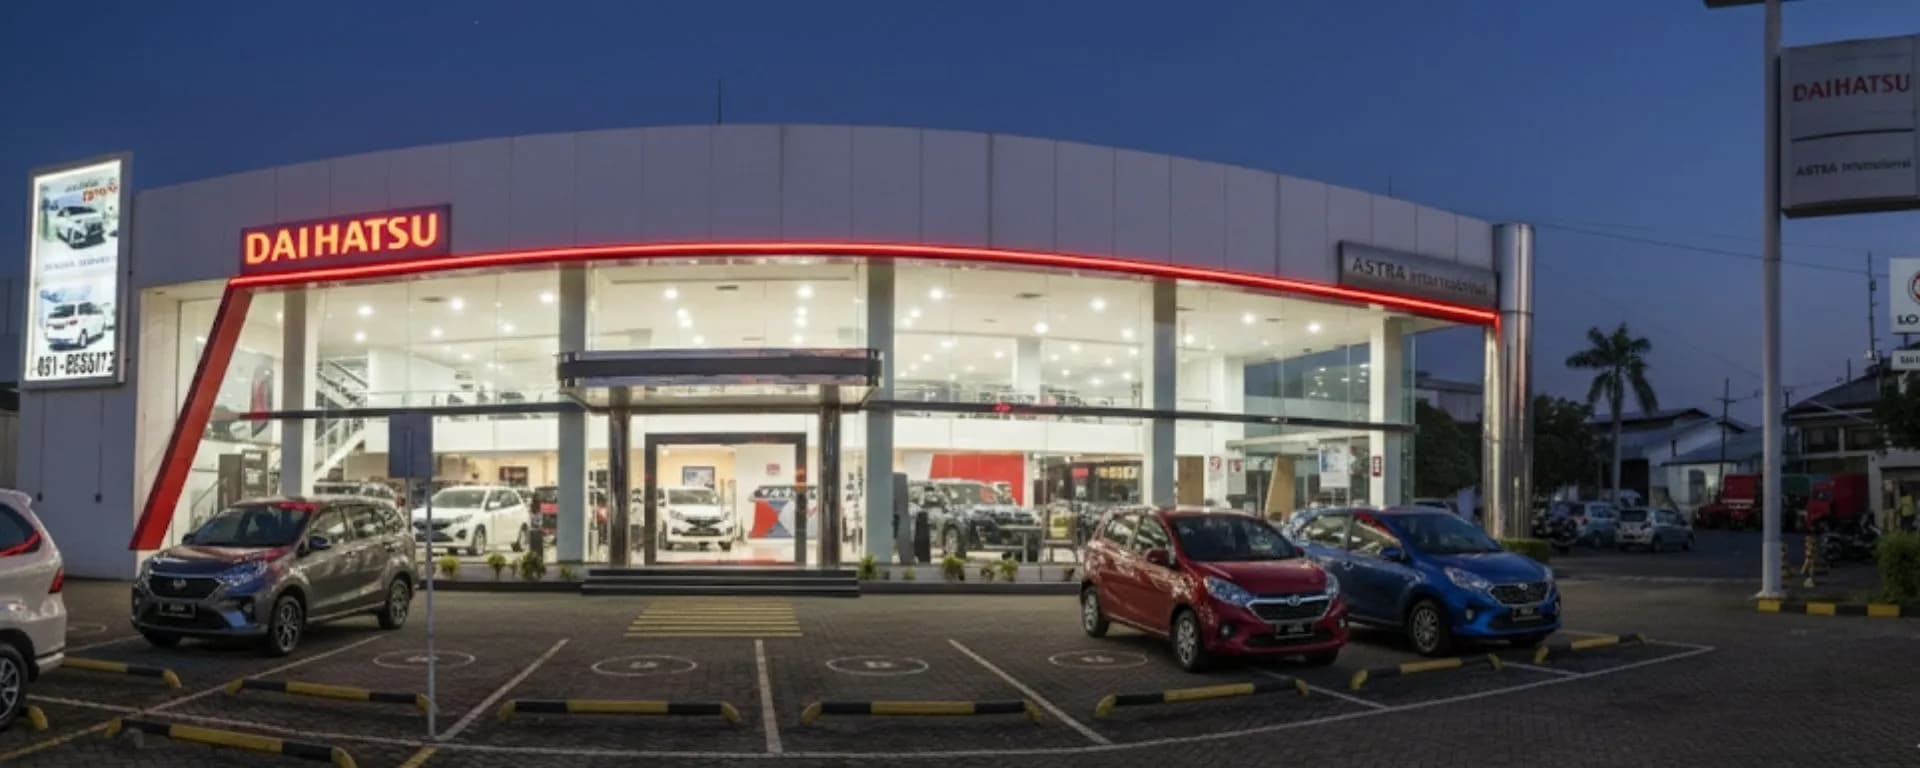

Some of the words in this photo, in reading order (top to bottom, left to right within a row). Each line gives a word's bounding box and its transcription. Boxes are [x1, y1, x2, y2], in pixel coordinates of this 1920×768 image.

[1792, 73, 1910, 102] DAIHATSU
[1796, 163, 1838, 176] ASTRA
[246, 213, 437, 265] DAIHATSU
[1352, 257, 1407, 280] ASTRA
